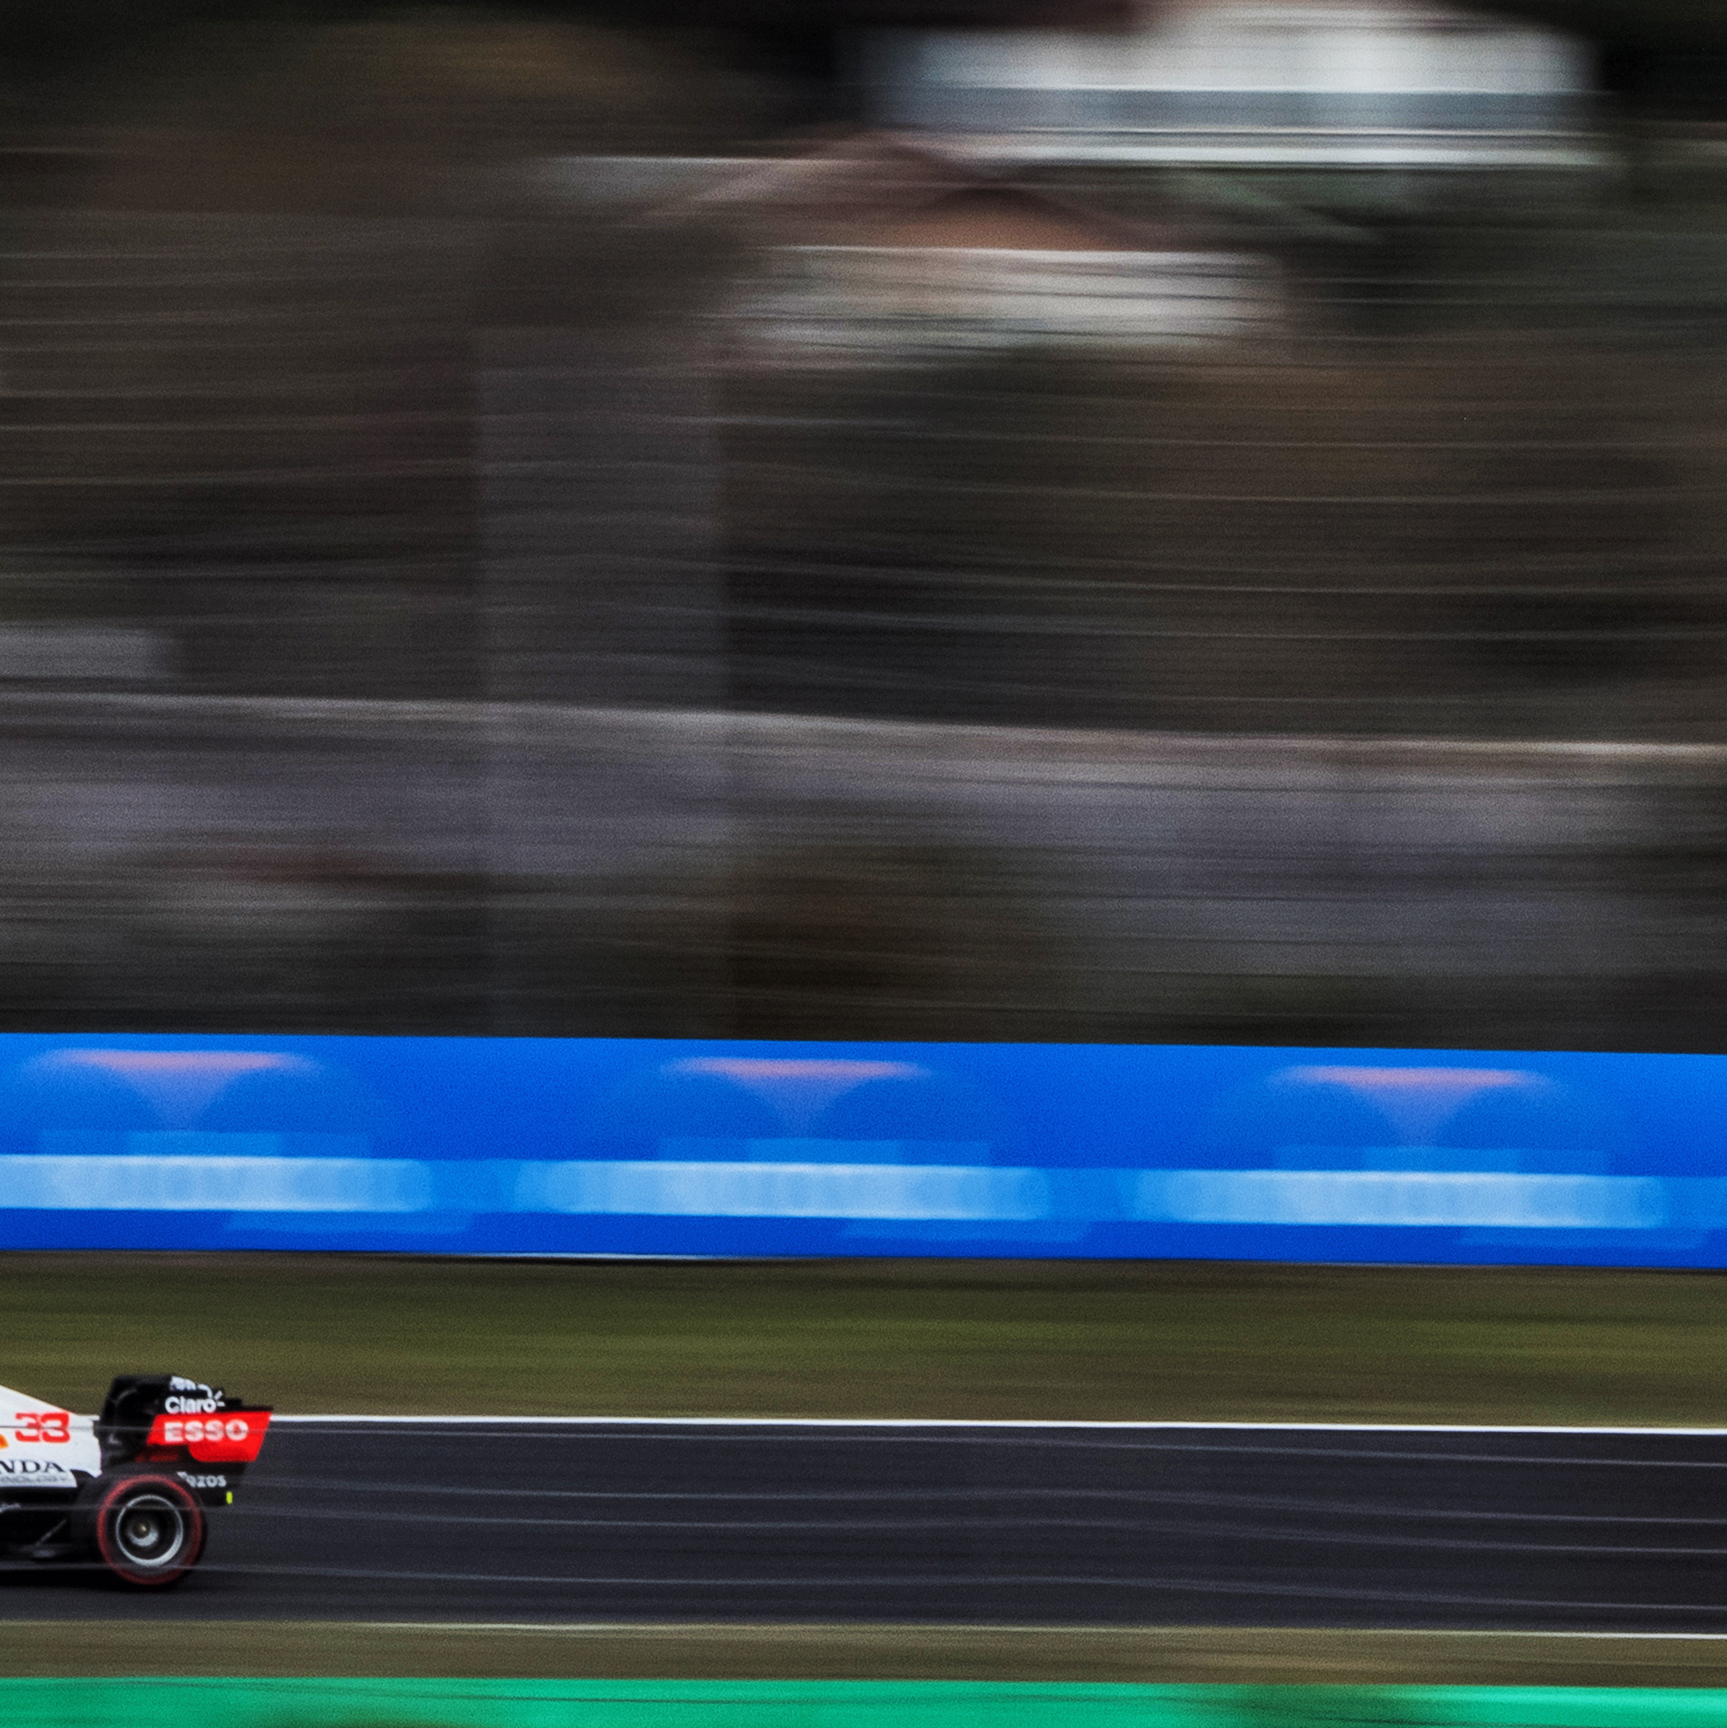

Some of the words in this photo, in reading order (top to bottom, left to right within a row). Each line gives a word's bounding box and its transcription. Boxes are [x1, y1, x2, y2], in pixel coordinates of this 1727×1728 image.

[164, 1396, 216, 1414] Claro
[15, 1412, 70, 1443] 33
[164, 1419, 249, 1442] ESSO
